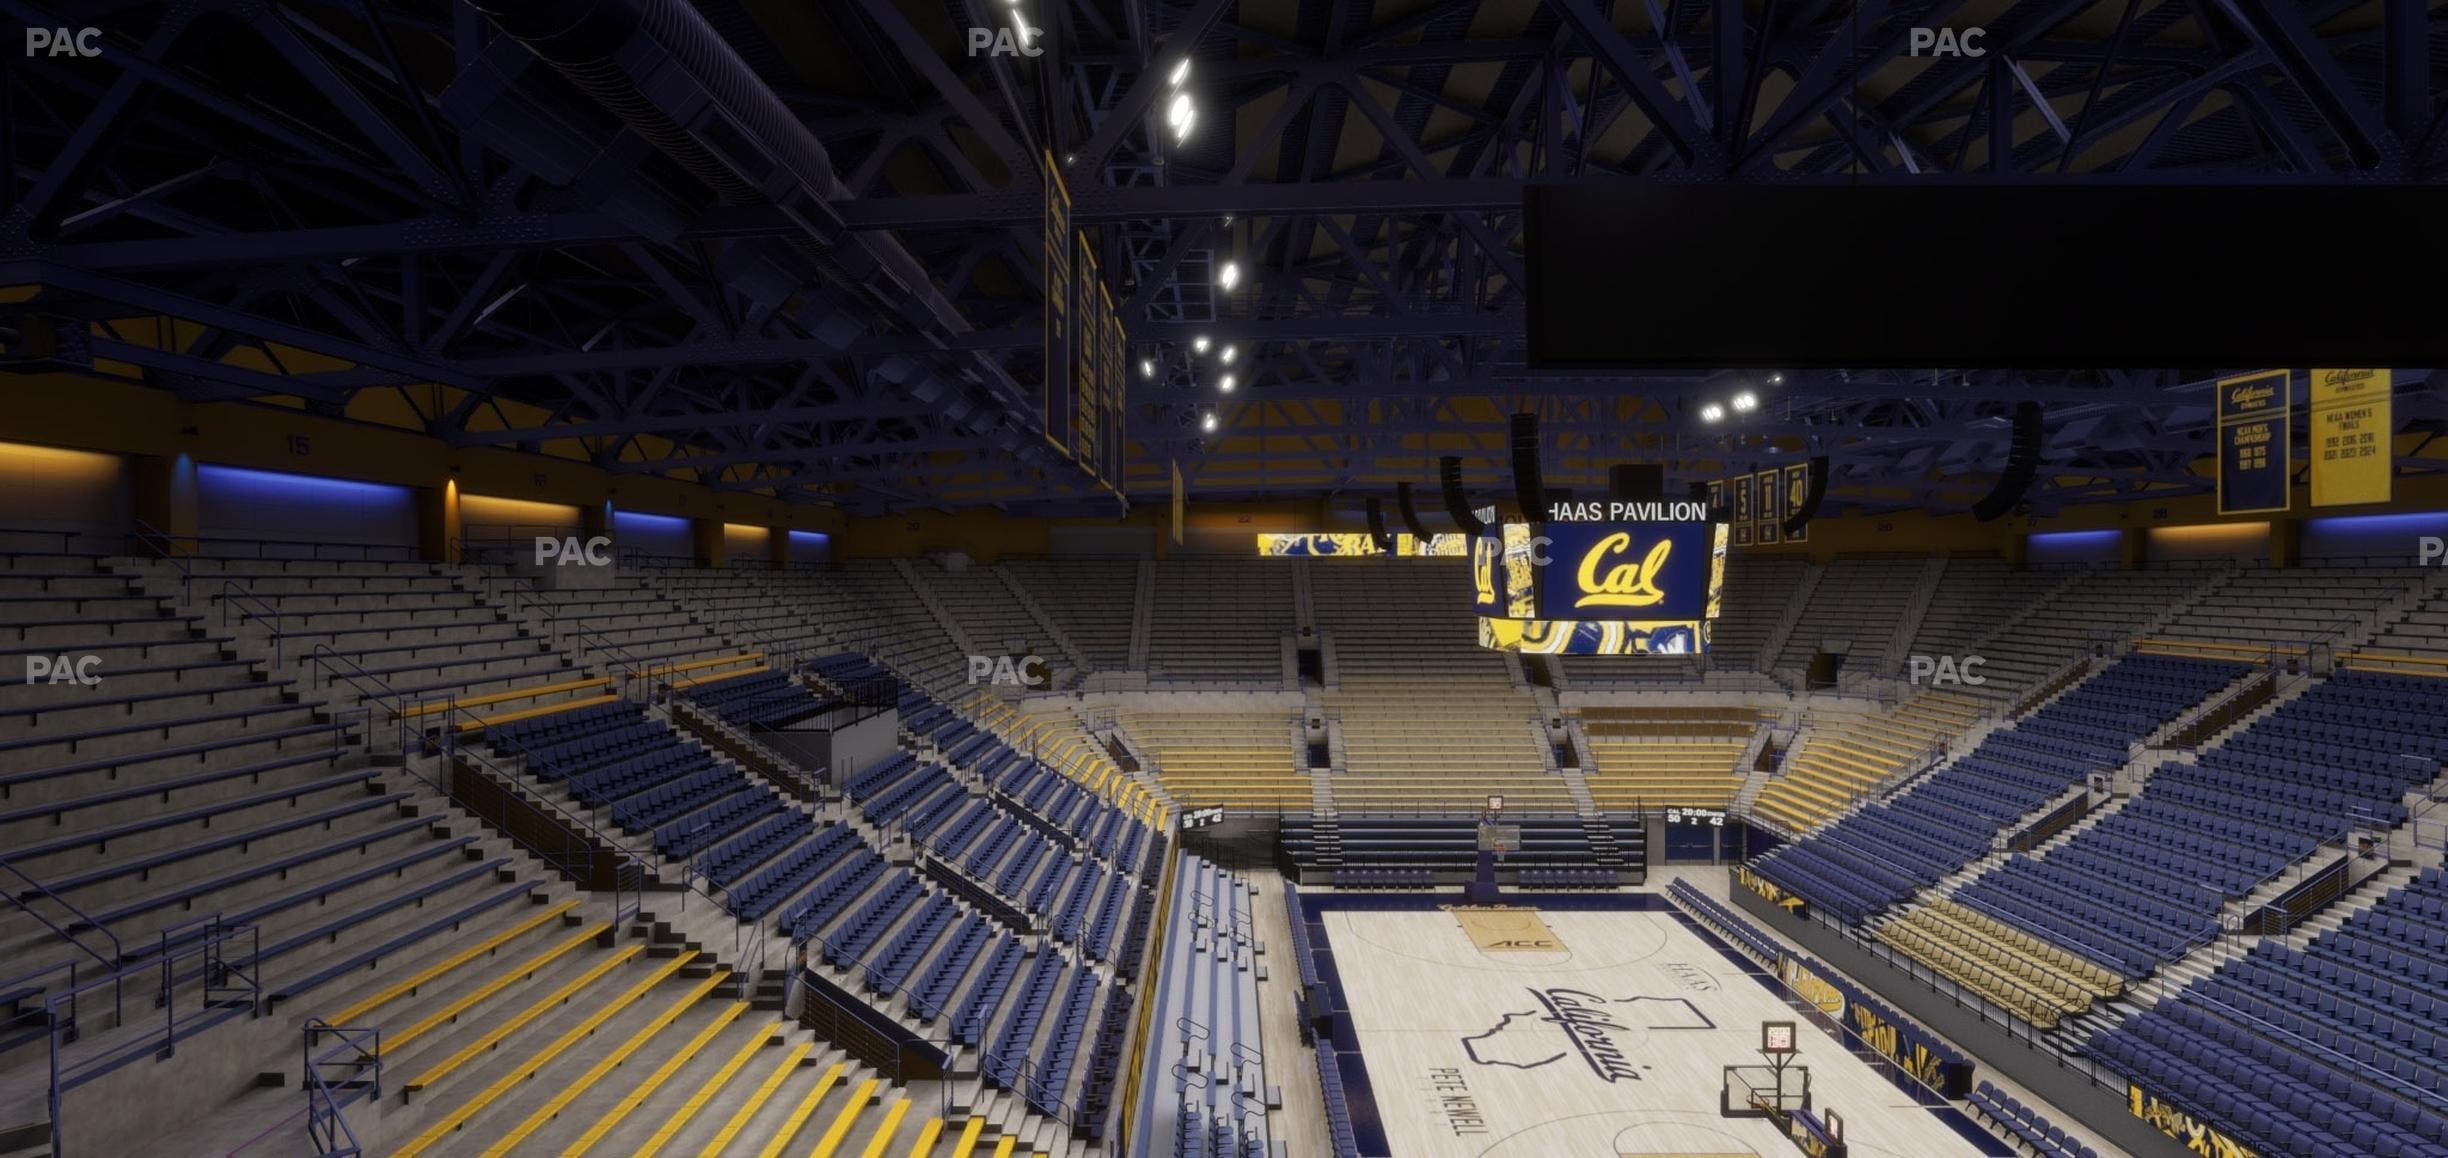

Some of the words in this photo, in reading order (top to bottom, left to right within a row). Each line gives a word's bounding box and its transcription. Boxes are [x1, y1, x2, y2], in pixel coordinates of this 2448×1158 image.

[287, 434, 312, 457] 15
[1548, 502, 1602, 521] HAAS
[1610, 502, 1706, 521] PAVILION
[1574, 531, 1672, 608] Cal
[1667, 814, 1681, 823] 50
[1690, 817, 1698, 825] 2
[1709, 817, 1724, 826] 42
[1681, 808, 1707, 816] 20:00
[1526, 986, 1642, 1083] California
[1429, 1067, 1468, 1091] PETE
[1440, 1096, 1489, 1137] NEWELL
